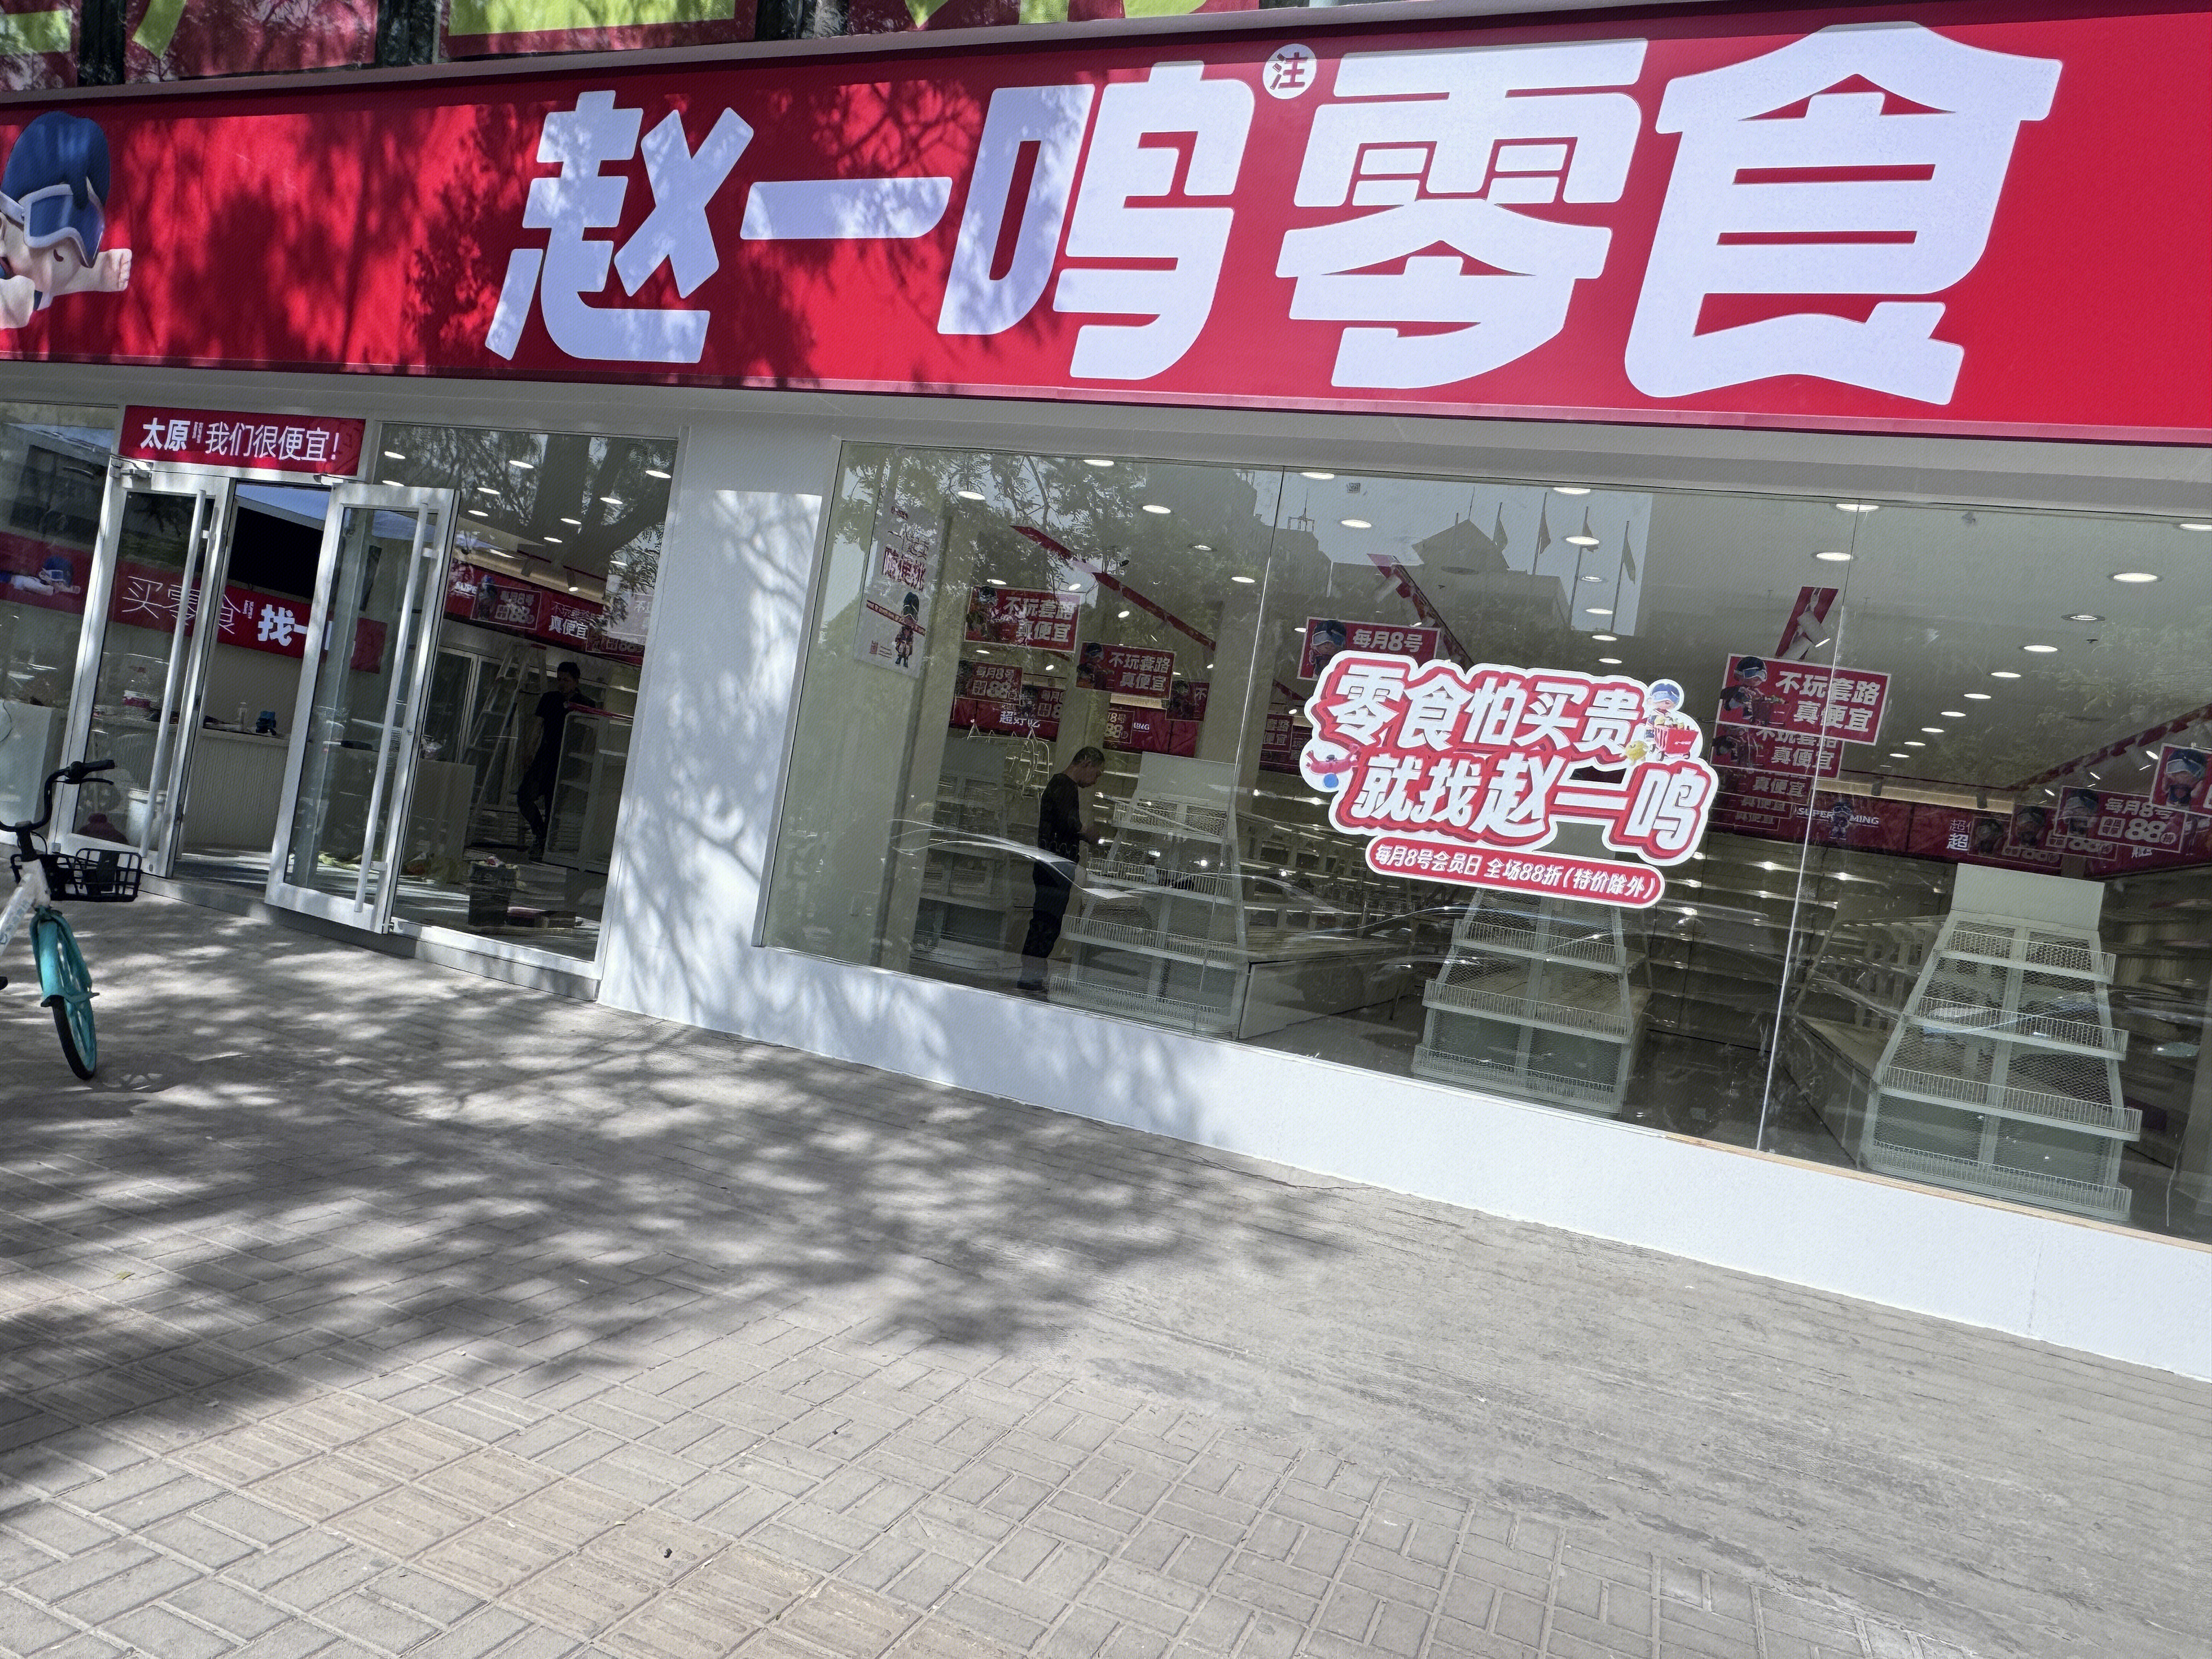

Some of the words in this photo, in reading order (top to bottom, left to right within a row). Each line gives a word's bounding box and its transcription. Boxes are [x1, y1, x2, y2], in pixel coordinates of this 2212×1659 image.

[1269, 52, 1308, 90] 注
[485, 21, 2063, 405] 赵一鸣零食
[140, 417, 190, 451] 太原
[205, 421, 340, 461] 我们很便宜！
[1003, 596, 1077, 620] 不玩套路
[1016, 619, 1071, 643] 真便宜
[1353, 629, 1423, 653] 每月8号
[1109, 652, 1170, 674] 不玩套路
[1120, 672, 1167, 692] 真便宜
[1775, 671, 1881, 706] 不玩套路
[1327, 663, 1641, 756] 零食怕买贵
[1793, 700, 1873, 732] 真便宜
[1770, 746, 1835, 770] 真便宜
[1351, 751, 1706, 850] 就找赵一鸣
[1375, 844, 1483, 876] 每月8号会员日
